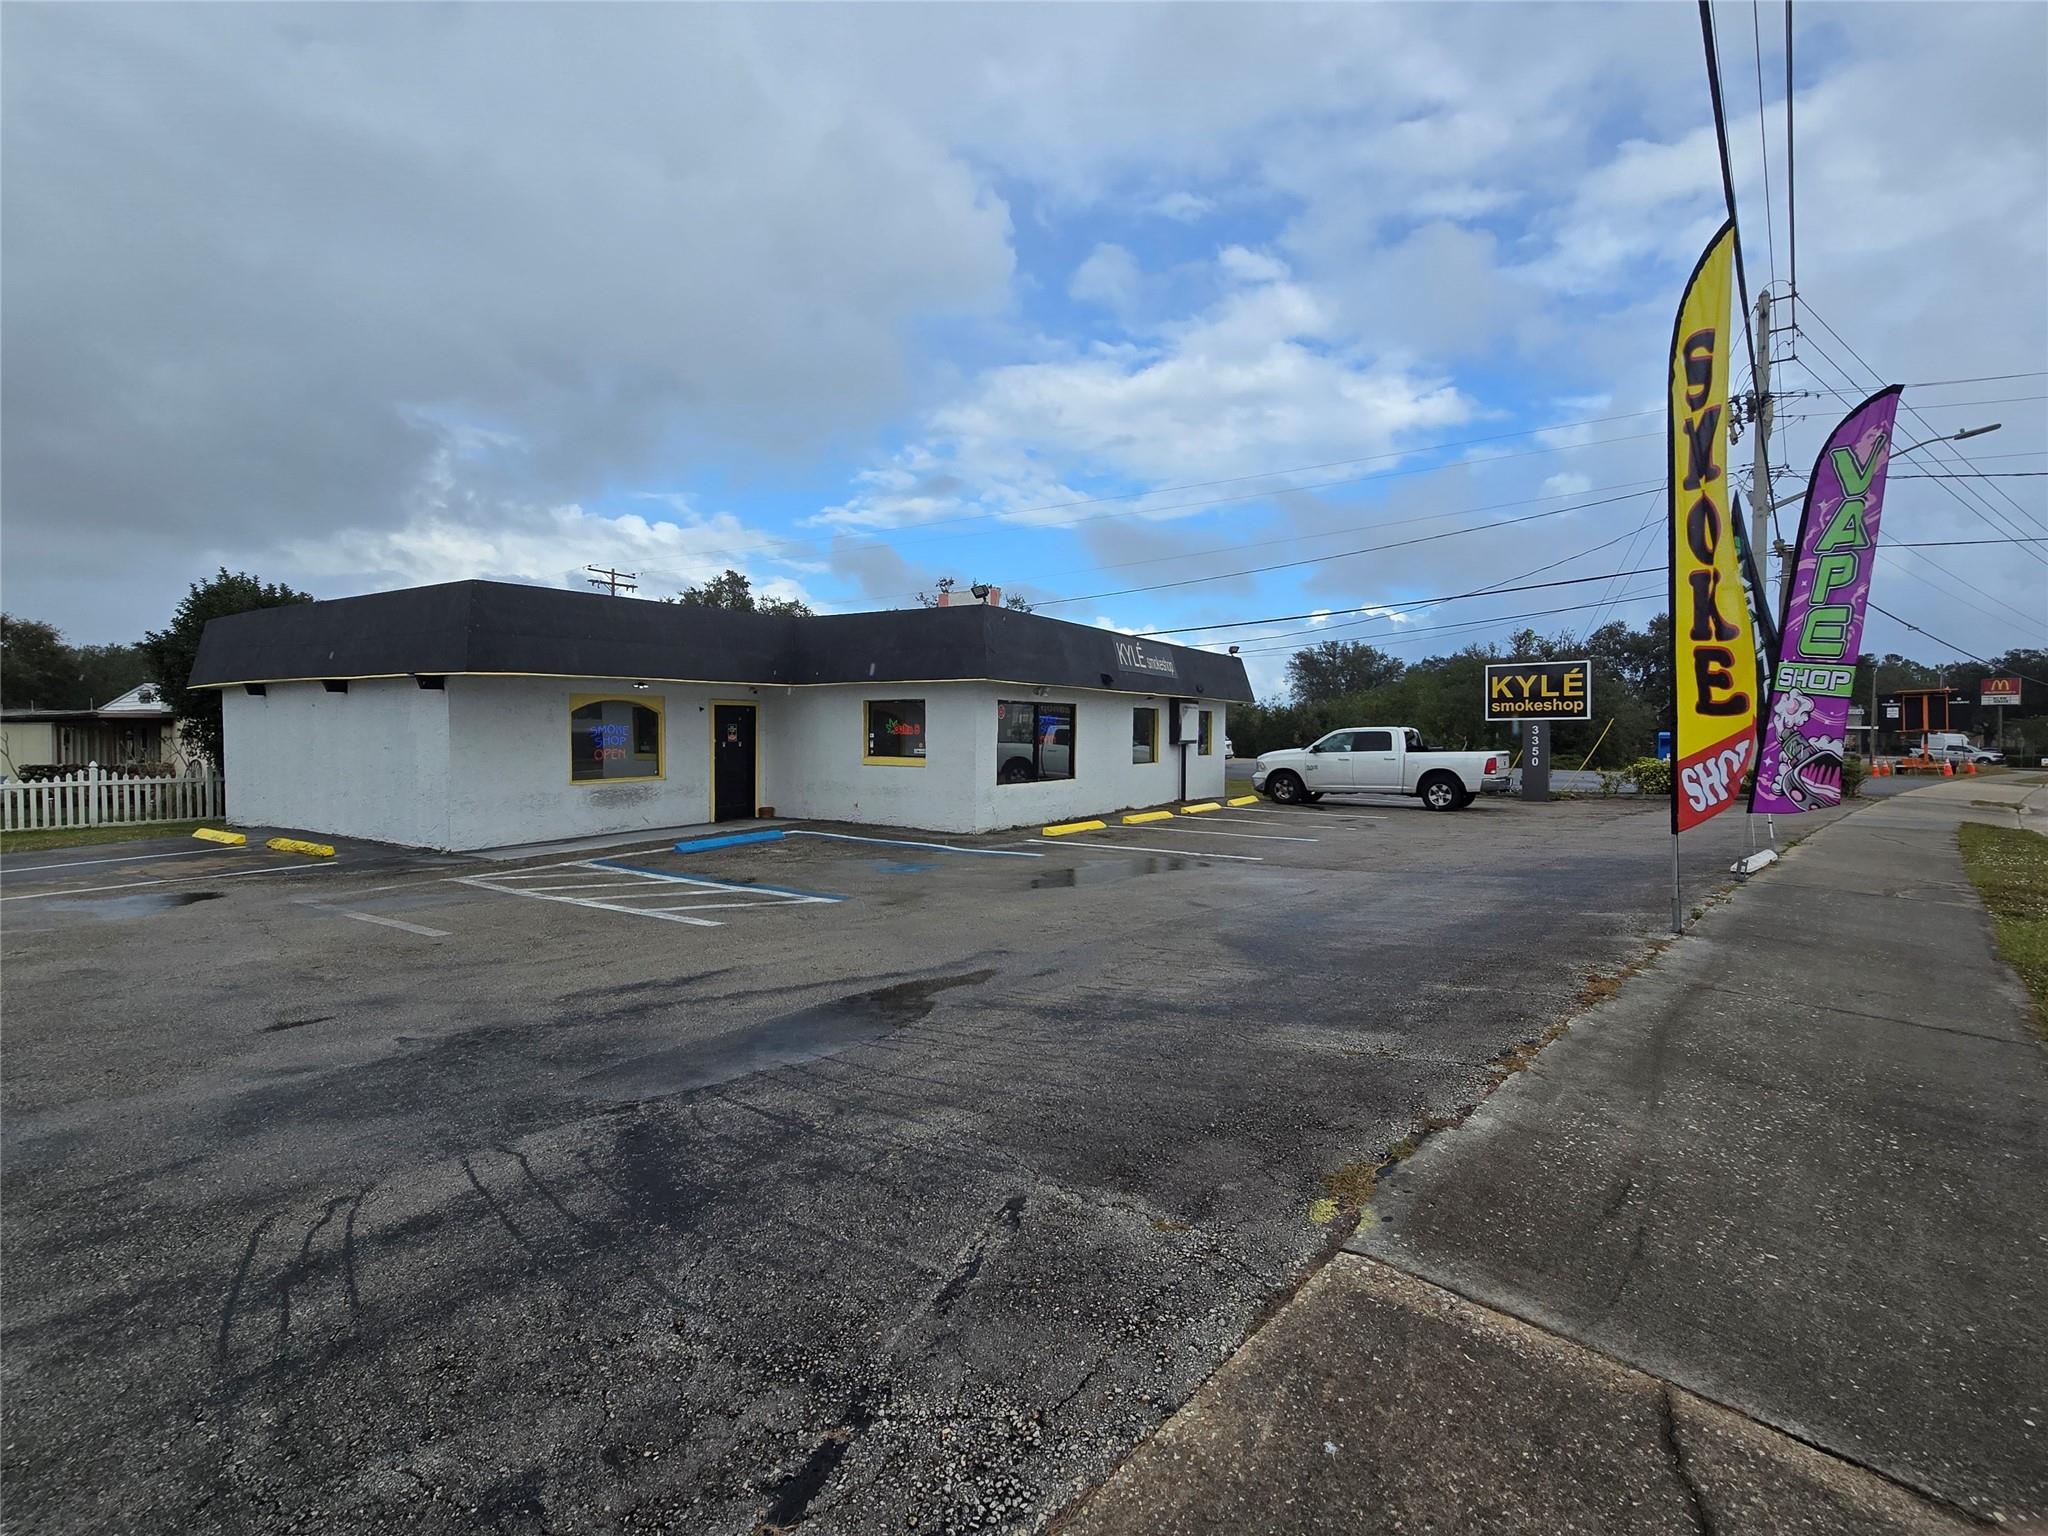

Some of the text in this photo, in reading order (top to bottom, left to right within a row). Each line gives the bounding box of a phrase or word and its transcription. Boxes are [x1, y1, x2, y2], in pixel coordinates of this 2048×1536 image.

[1683, 328, 1751, 717] SMOKE
[1798, 431, 1887, 660] VAPE
[1491, 668, 1584, 698] KYLÉ
[1777, 668, 1851, 690] SHOP
[1491, 698, 1584, 713] smokeshop
[593, 748, 626, 760] OPEN
[594, 736, 626, 748] SHOP
[1531, 725, 1540, 767] 3350
